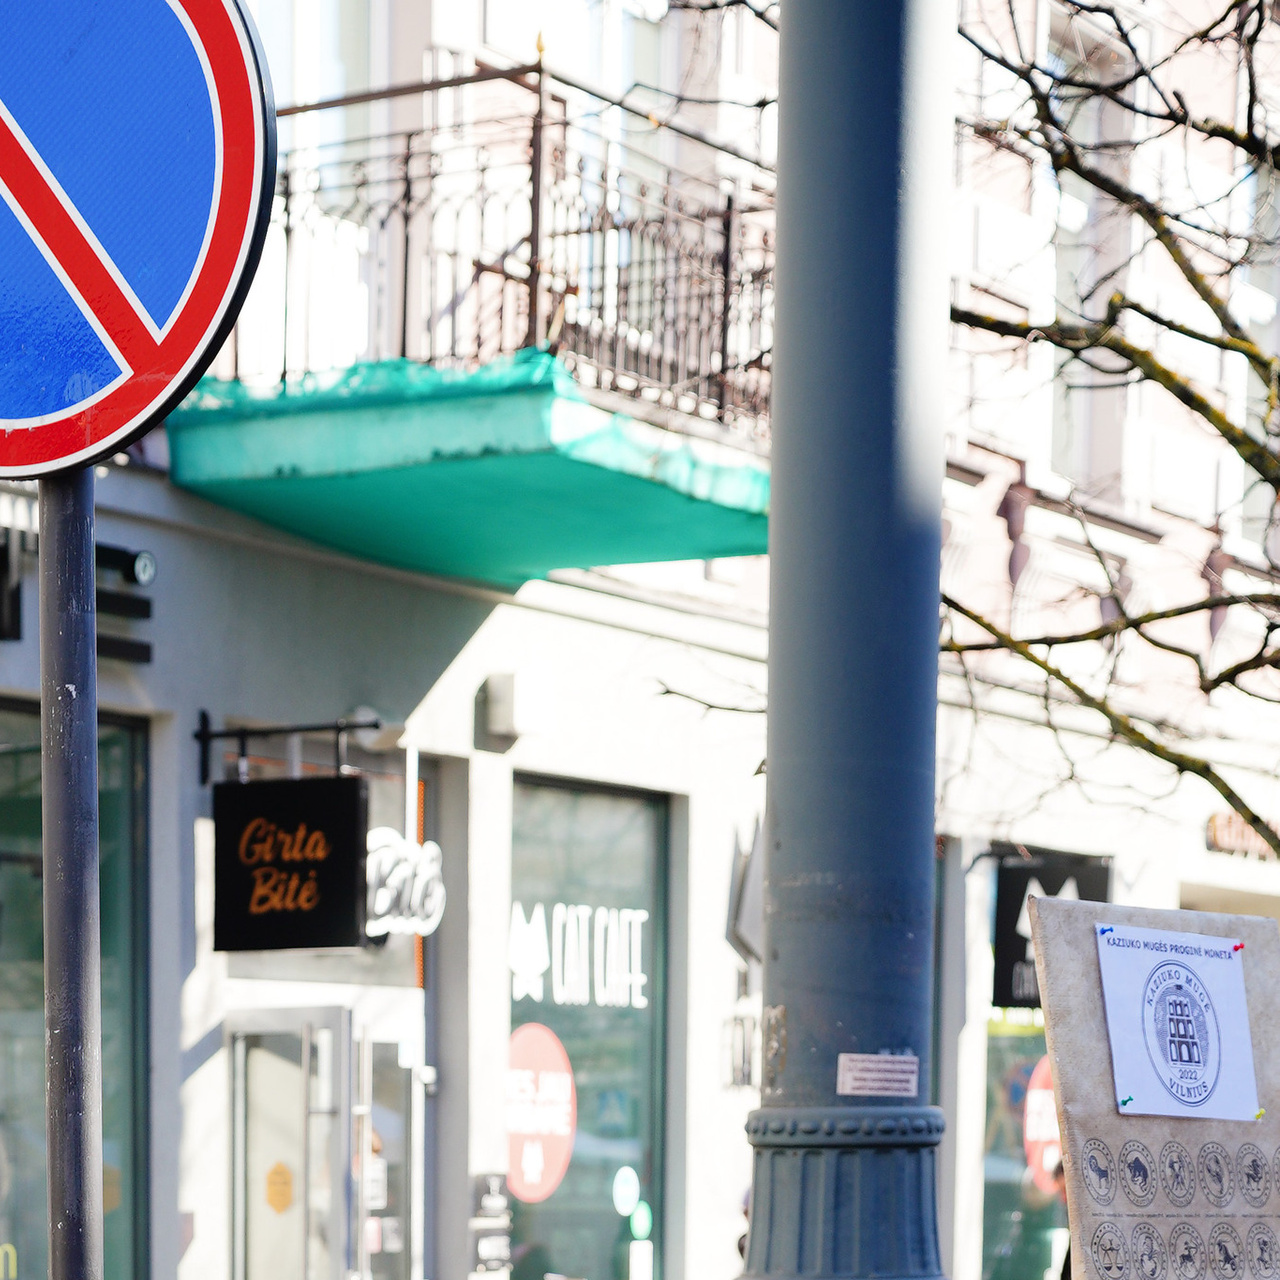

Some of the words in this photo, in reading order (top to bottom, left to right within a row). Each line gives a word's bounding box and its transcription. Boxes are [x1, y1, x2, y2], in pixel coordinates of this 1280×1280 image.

[239, 817, 332, 865] Girta
[1106, 937, 1141, 949] KAZIUKO
[1204, 948, 1233, 960] MONETA
[1178, 1069, 1198, 1080] 2022
[1169, 1077, 1209, 1098] VILNIUS
